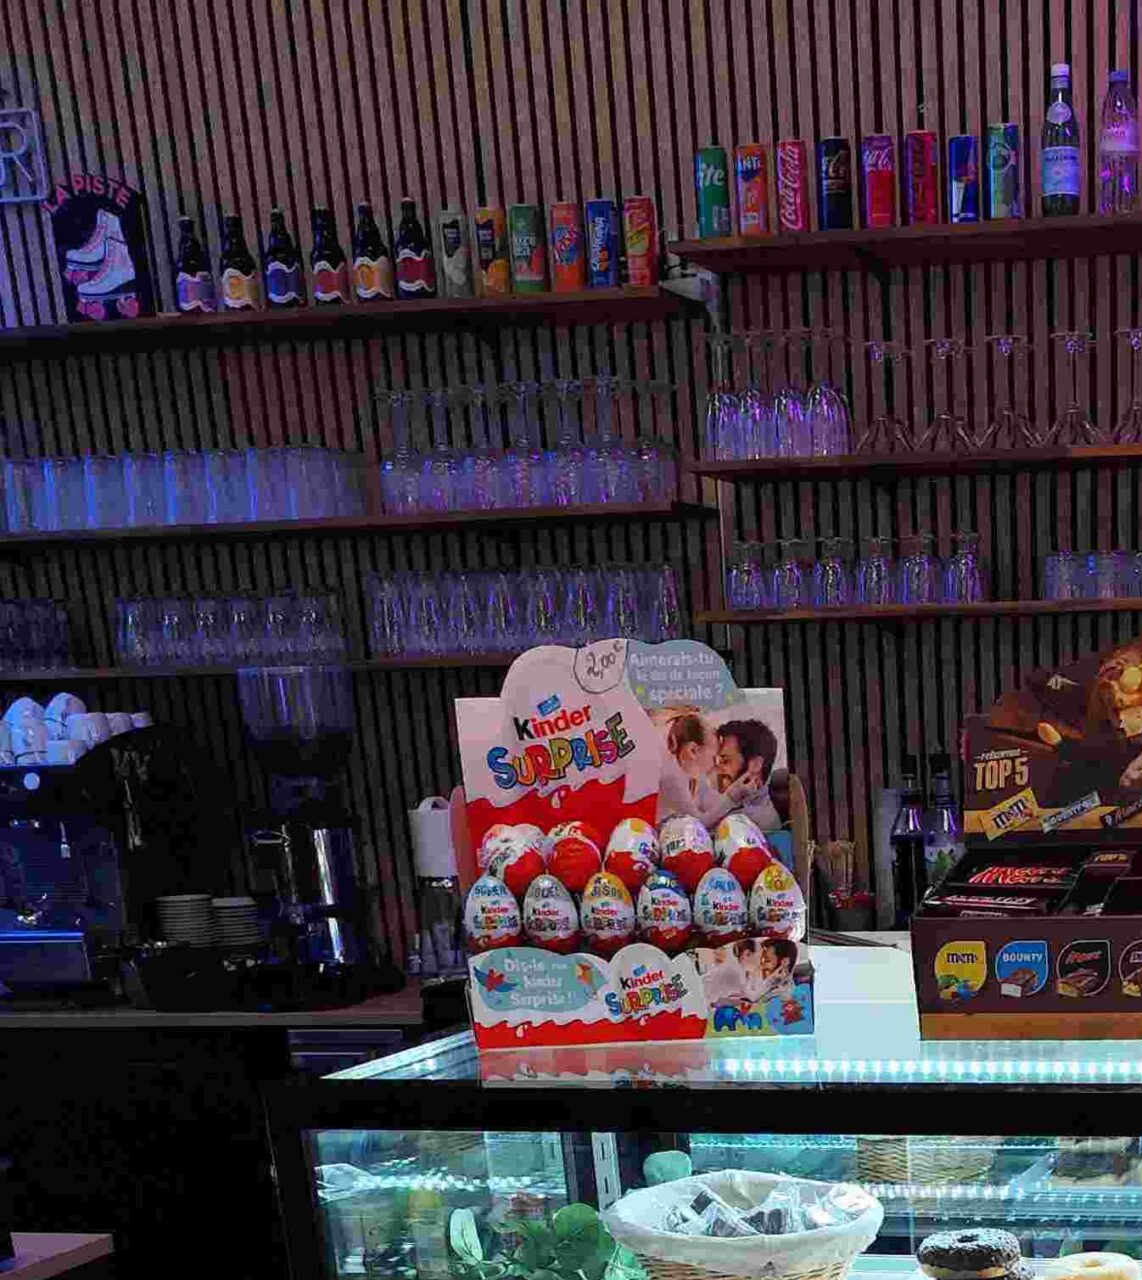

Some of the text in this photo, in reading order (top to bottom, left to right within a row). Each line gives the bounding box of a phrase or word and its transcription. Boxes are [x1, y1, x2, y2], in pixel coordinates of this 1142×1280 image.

[41, 172, 133, 214] LA PISTE
[513, 704, 592, 741] Kinder
[487, 712, 636, 789] SURPRISE
[973, 756, 1029, 791] TOP 5
[1002, 952, 1044, 963] BOUNTY
[605, 973, 687, 1017] SURPRISE
[619, 968, 665, 992] Kinder
